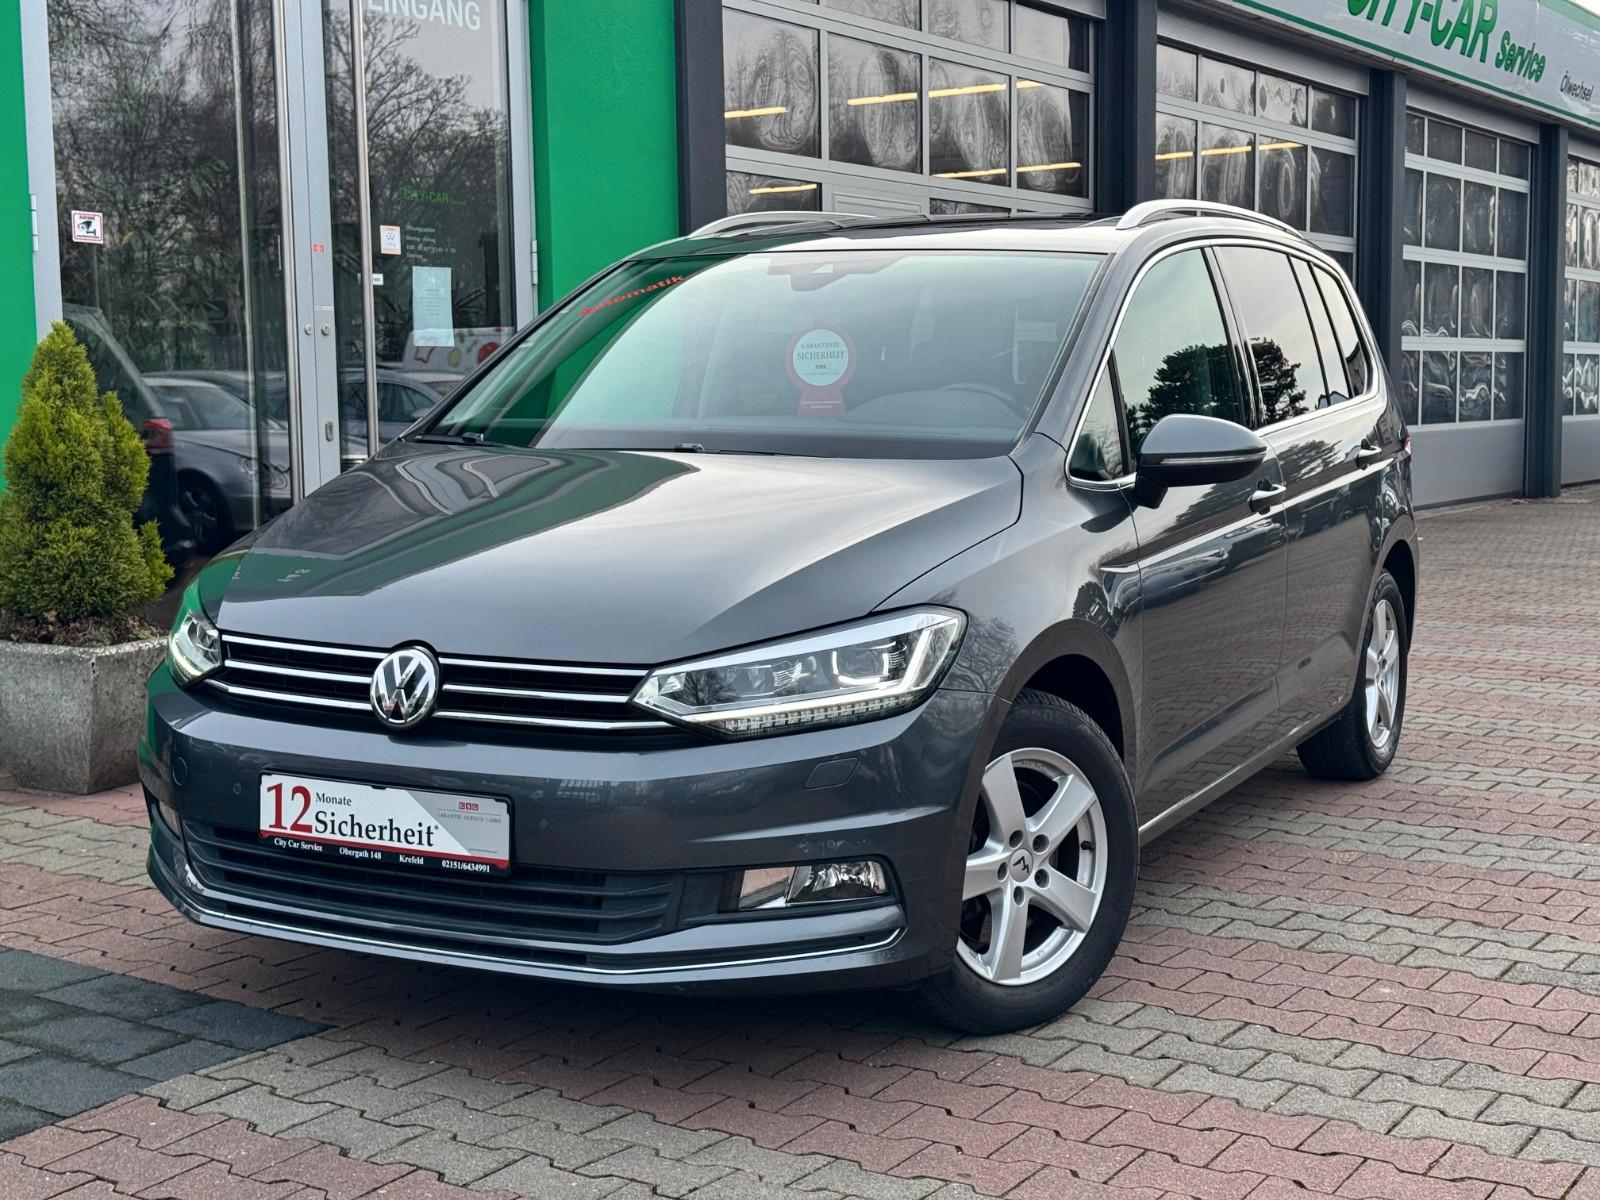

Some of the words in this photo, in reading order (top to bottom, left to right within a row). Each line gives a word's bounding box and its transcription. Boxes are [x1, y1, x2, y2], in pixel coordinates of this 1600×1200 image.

[1347, 0, 1498, 63] Y-CAR
[1495, 30, 1546, 83] Service
[1559, 71, 1594, 102] Ölwechsel
[796, 350, 845, 361] SICHERHEIT
[266, 782, 312, 833] 12
[315, 792, 352, 806] Monate
[274, 837, 287, 848] City
[287, 838, 300, 848] Car
[300, 841, 323, 852] Service
[339, 847, 369, 859] Obergath
[370, 850, 382, 860] 148
[399, 854, 424, 865] Krefeld
[441, 859, 490, 873] 02151/6434991
